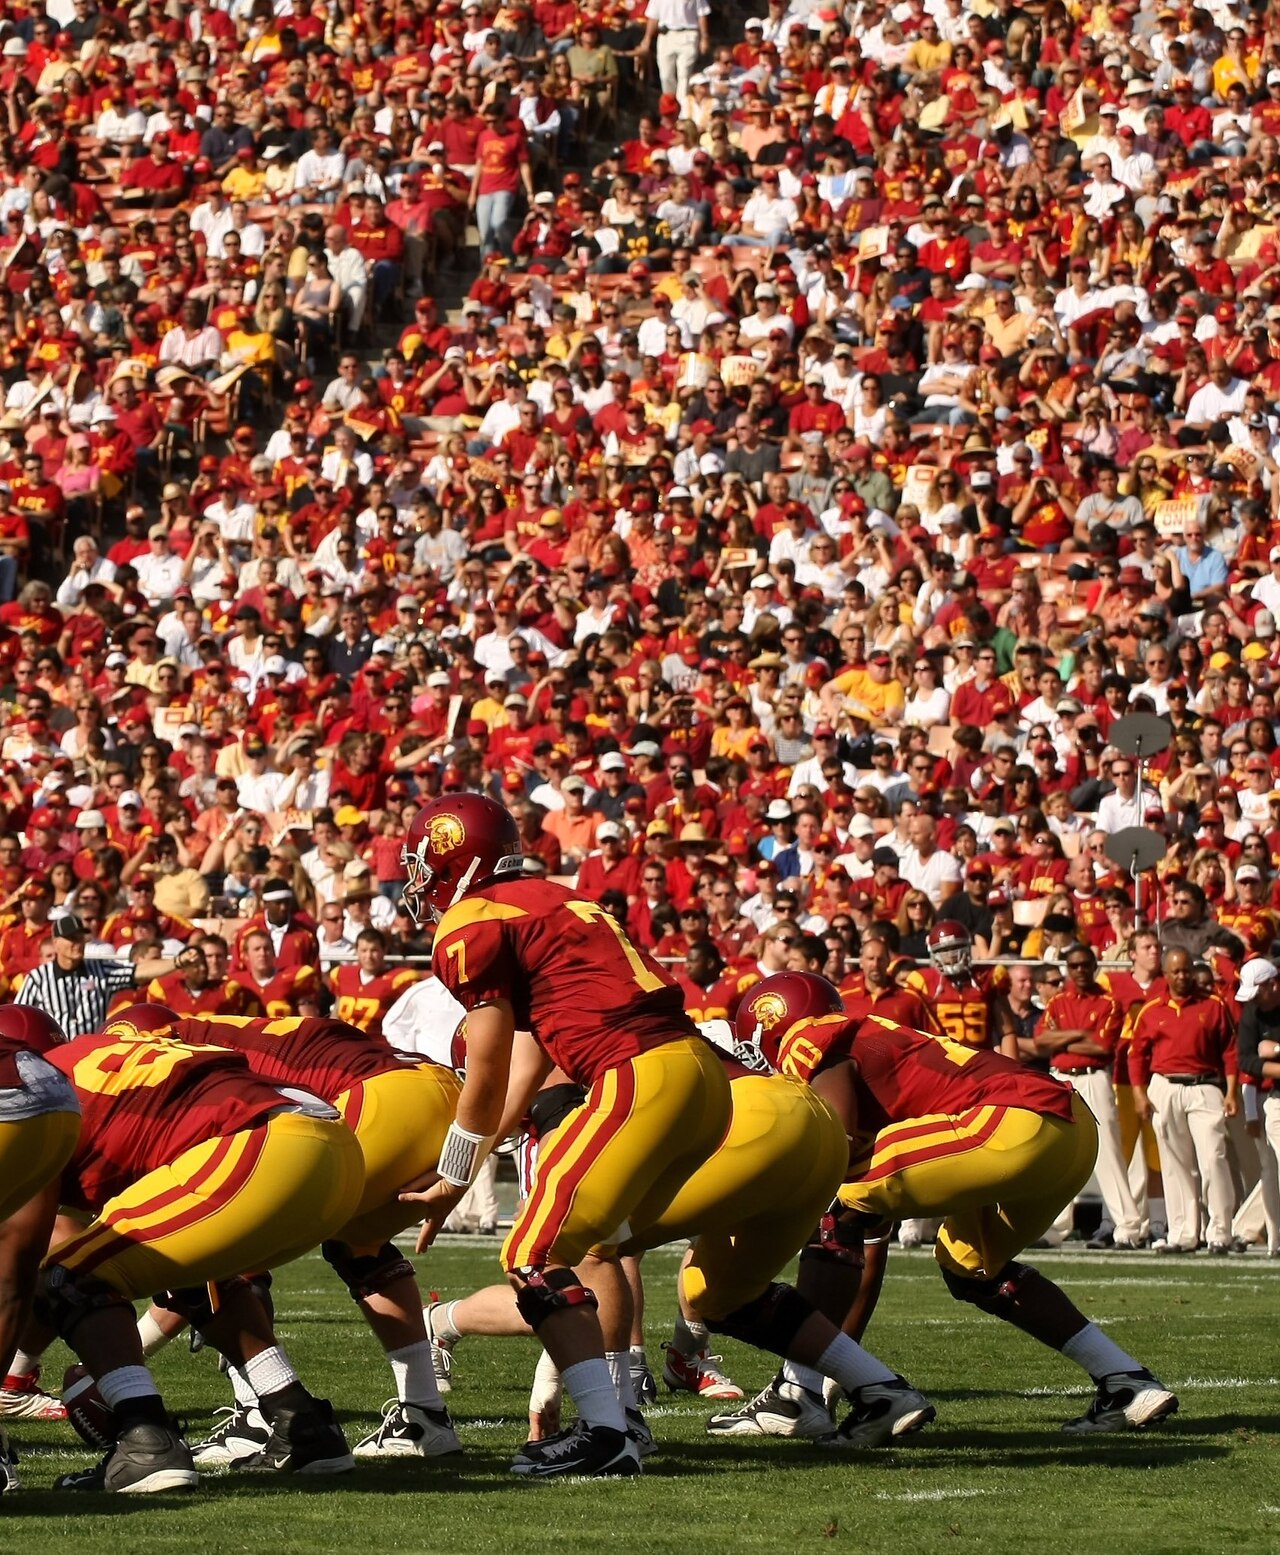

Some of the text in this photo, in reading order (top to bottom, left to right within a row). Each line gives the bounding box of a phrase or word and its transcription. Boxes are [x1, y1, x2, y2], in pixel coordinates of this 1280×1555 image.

[1157, 501, 1195, 512] FIGHT
[445, 939, 469, 984] 7
[564, 901, 666, 994] 7
